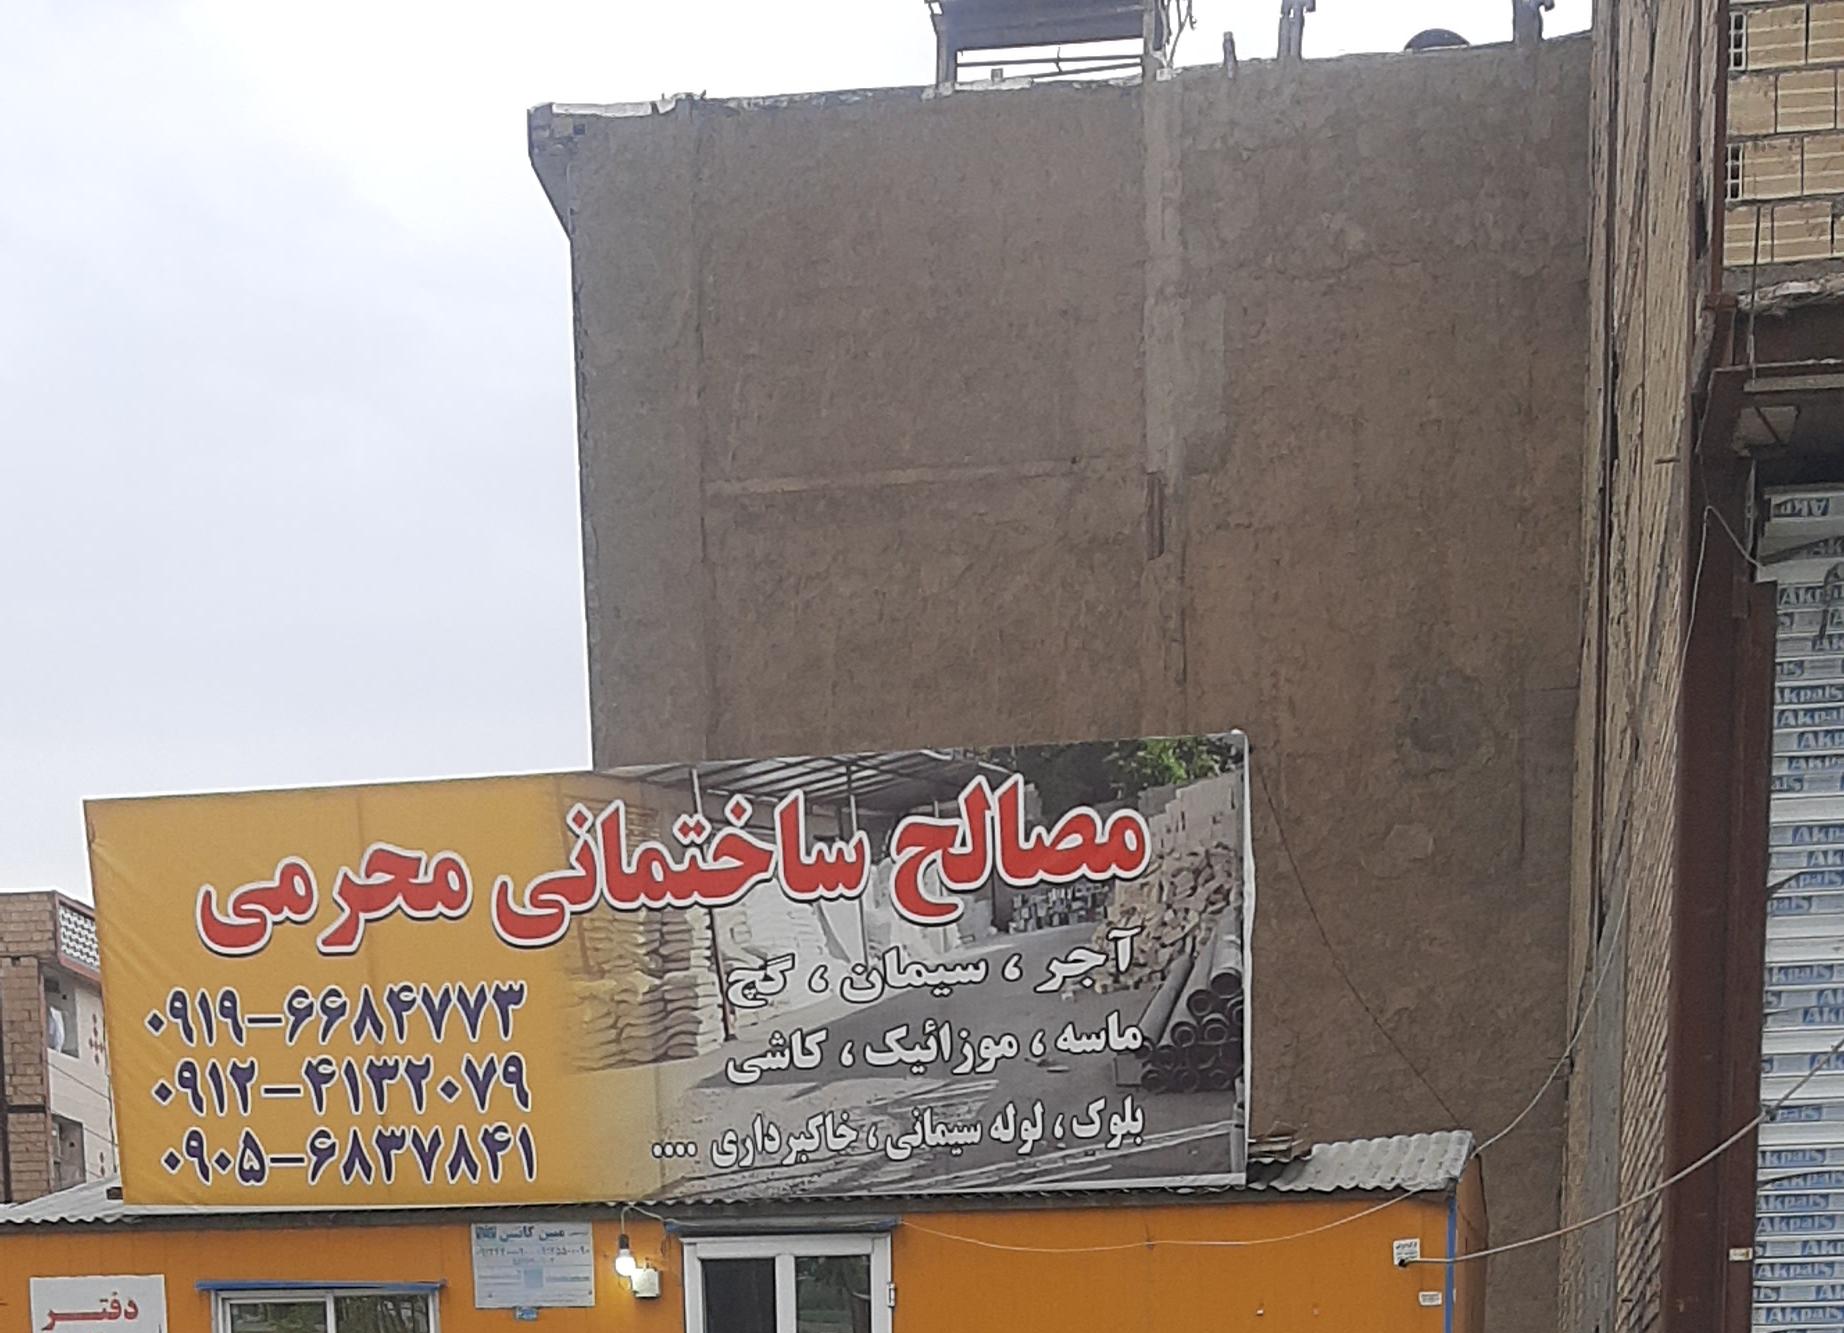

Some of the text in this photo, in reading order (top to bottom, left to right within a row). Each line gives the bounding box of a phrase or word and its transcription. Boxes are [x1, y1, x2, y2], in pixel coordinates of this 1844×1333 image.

[197, 773, 1151, 953] مصالح ساختمانی محرمی
[727, 952, 795, 1006] گچ
[841, 954, 987, 1001] سیمان
[1035, 929, 1142, 991] آجر
[726, 1028, 829, 1084] کاشی
[865, 1022, 1019, 1076] موزائیک
[1056, 1011, 1144, 1053] ماسه
[710, 1113, 859, 1166] خاکبرداری
[884, 1107, 982, 1159] سیمانی
[990, 1102, 1044, 1153] لوله
[1070, 1099, 1145, 1149] بلوک
[41, 1291, 139, 1331] دفتر
